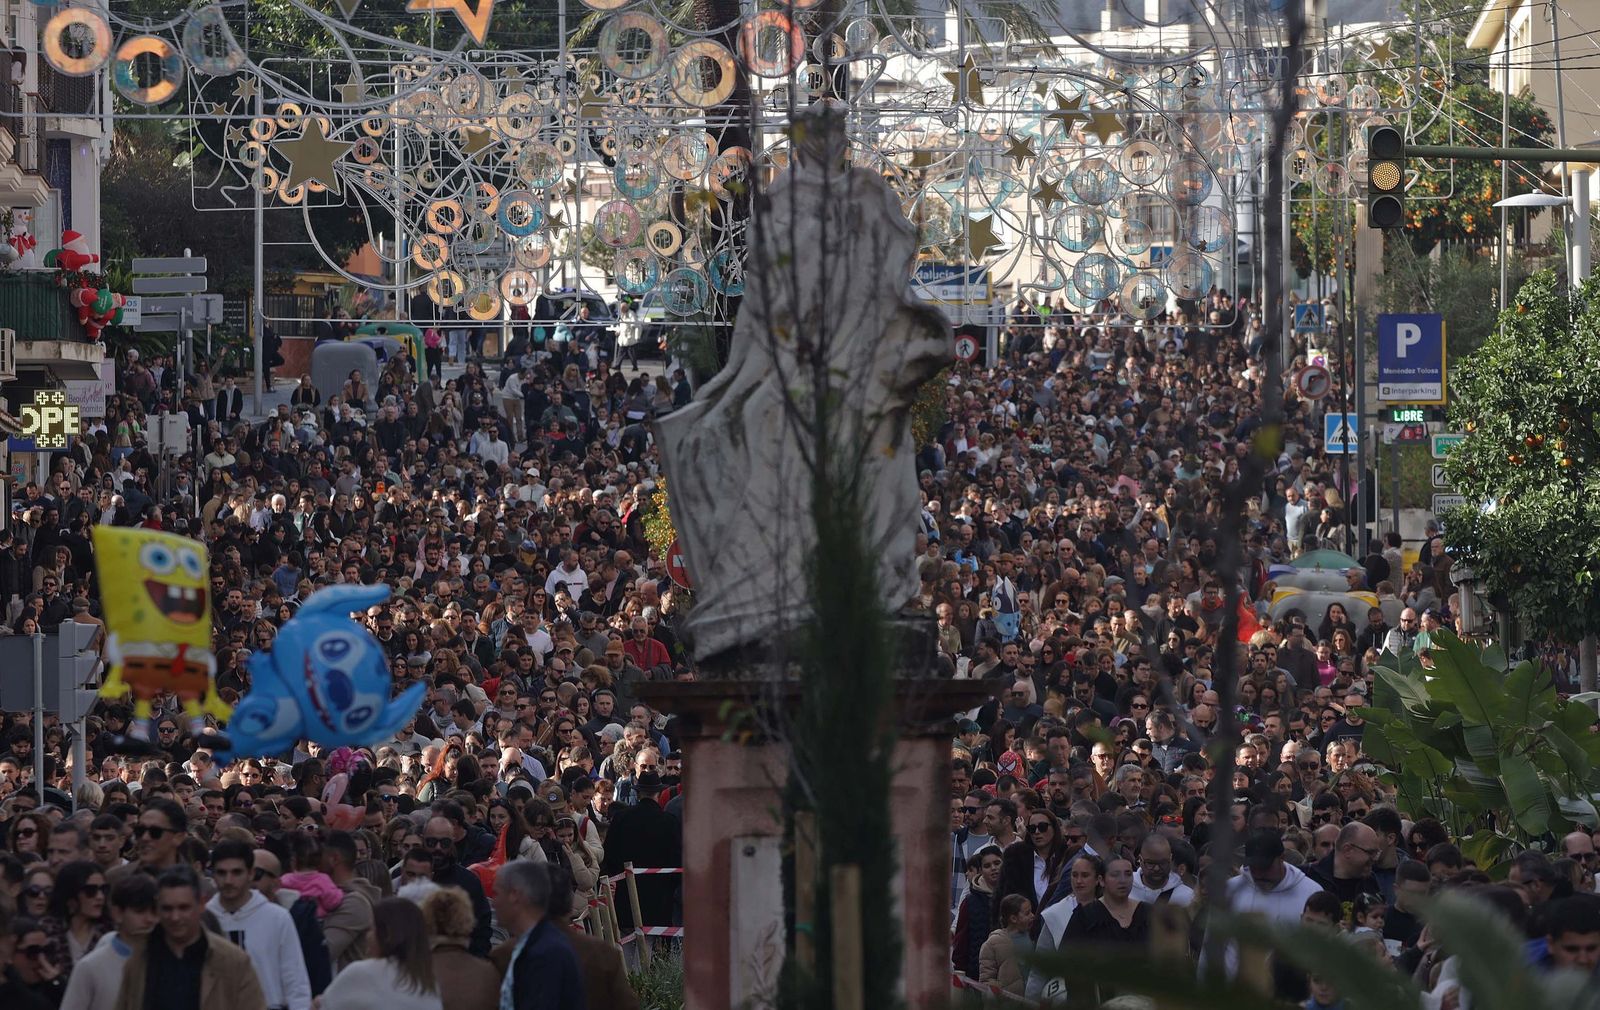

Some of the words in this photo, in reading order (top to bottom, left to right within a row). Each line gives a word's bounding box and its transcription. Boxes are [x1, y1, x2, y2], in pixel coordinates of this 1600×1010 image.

[1397, 323, 1422, 358] P
[1383, 367, 1415, 375] Menéndez
[1417, 367, 1439, 375] Tolosa
[1391, 387, 1437, 396] Interparking
[1393, 410, 1424, 422] LIBRE
